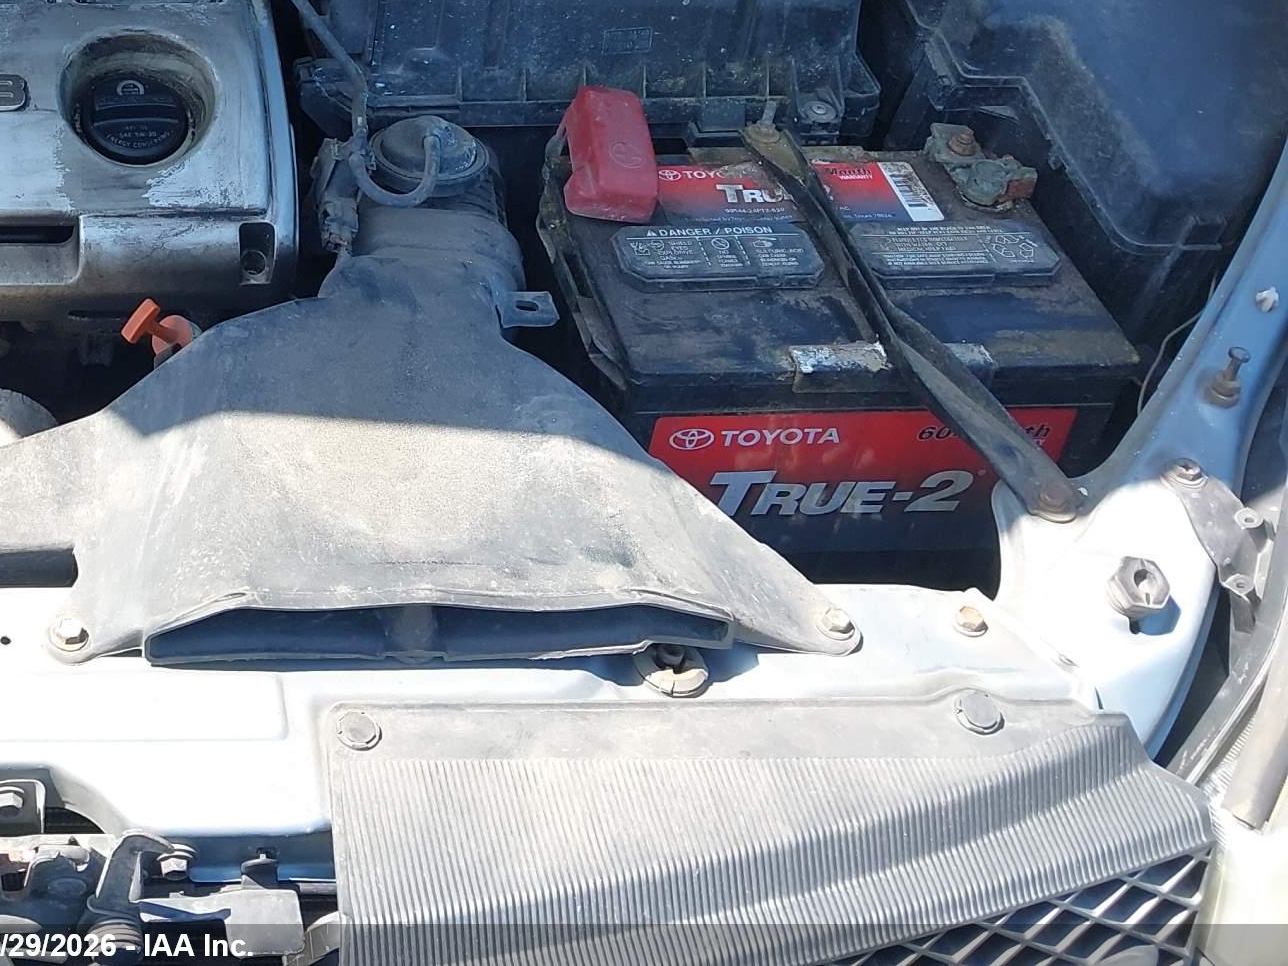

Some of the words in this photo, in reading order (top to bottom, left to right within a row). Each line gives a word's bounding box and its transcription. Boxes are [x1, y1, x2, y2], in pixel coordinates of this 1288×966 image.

[659, 228, 712, 237] DANGER
[724, 226, 773, 234] POISON
[721, 427, 841, 447] TOYOTA
[710, 469, 974, 517] TRUE-2
